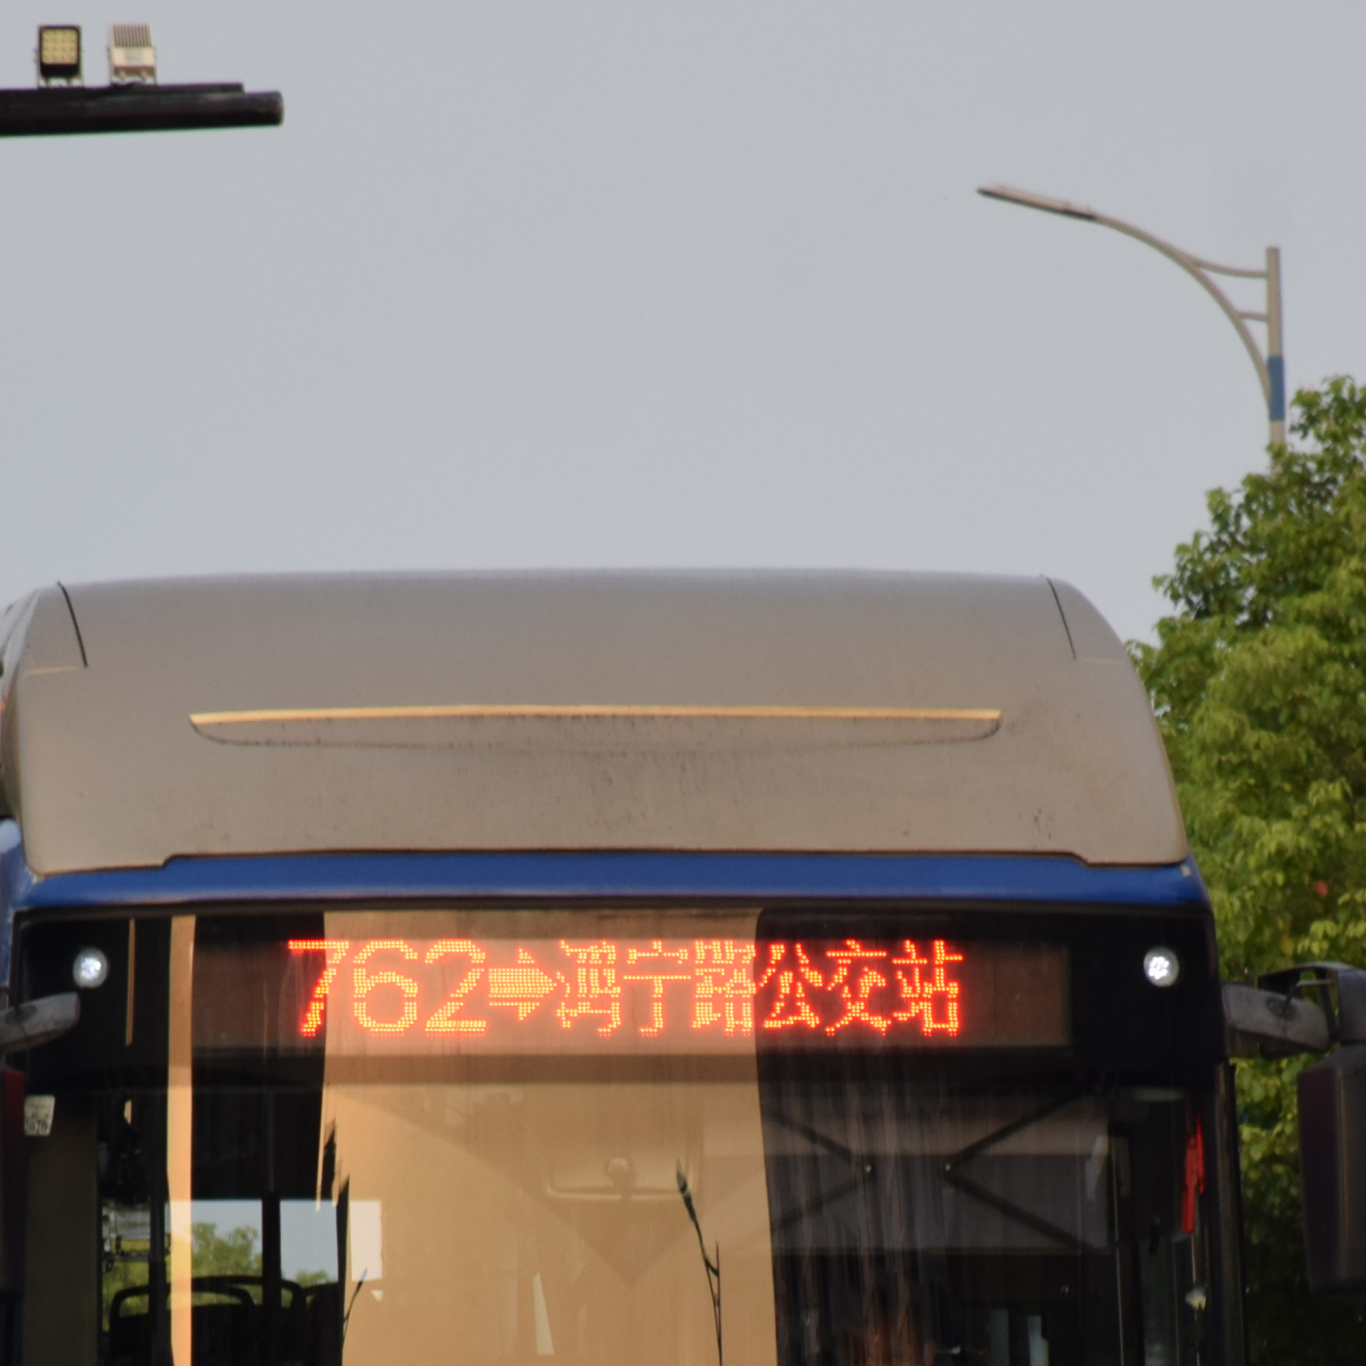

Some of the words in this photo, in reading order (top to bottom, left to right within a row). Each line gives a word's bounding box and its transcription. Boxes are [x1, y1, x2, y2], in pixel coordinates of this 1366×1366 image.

[288, 938, 487, 1038] 762
[556, 938, 964, 1038] 鸿宁路公交站
